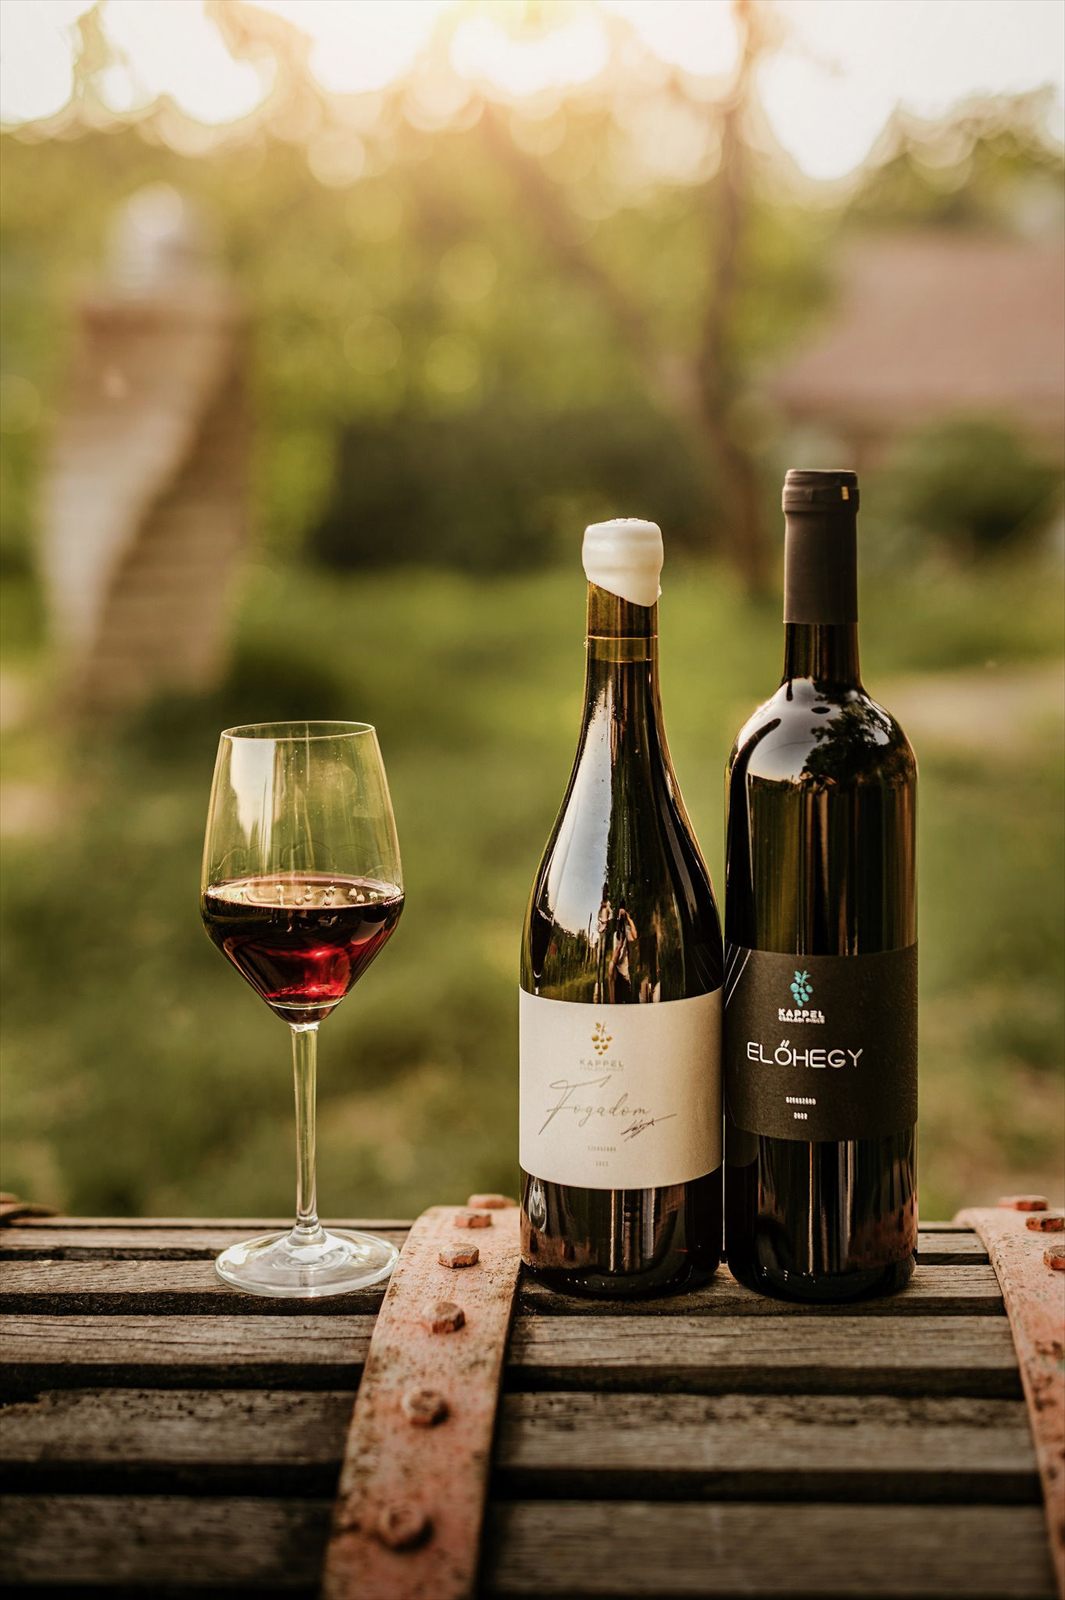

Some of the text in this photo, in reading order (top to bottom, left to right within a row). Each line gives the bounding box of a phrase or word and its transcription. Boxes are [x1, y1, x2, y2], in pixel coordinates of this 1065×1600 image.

[778, 1008, 825, 1018] KAPPEL
[747, 1039, 863, 1068] ELŐHEGY
[579, 1059, 624, 1068] KAPPEL
[538, 1074, 652, 1136] Fogadom
